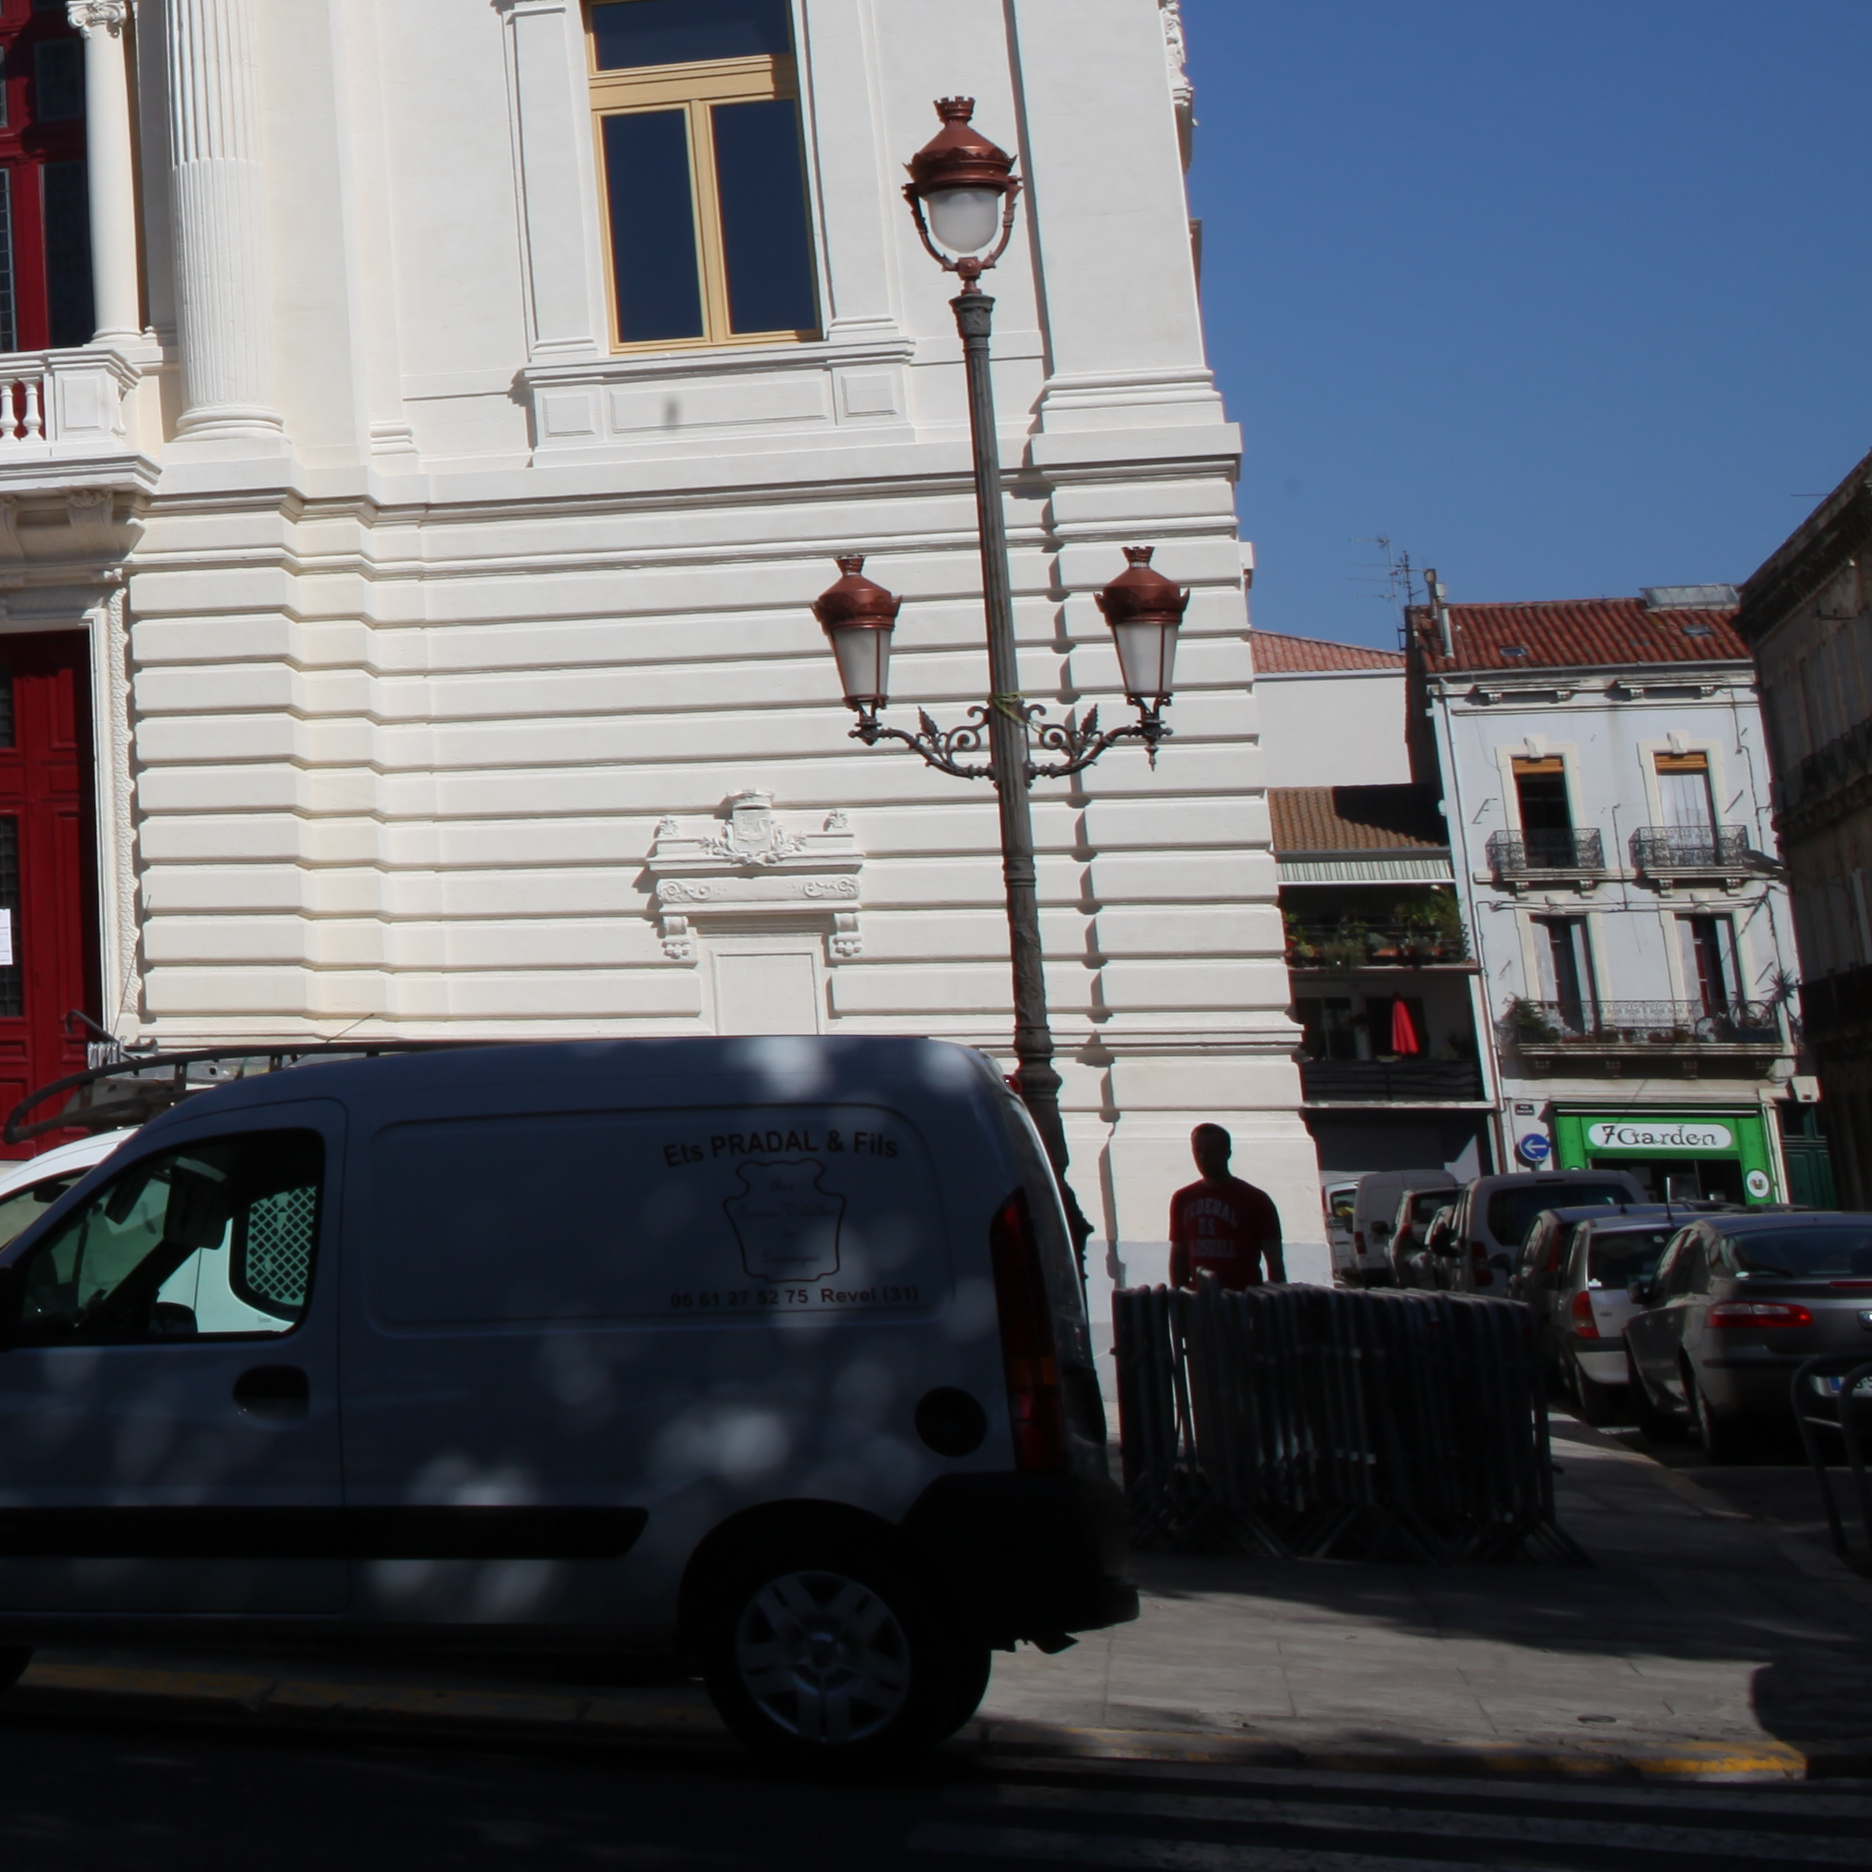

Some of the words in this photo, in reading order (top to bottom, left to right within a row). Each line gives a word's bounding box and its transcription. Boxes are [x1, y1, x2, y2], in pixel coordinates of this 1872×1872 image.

[662, 1143, 704, 1168] Ets
[710, 1130, 819, 1158] PRADAL
[826, 1129, 845, 1153] &
[853, 1131, 899, 1159] Fils
[670, 1292, 693, 1308] 05
[699, 1291, 720, 1307] 61
[728, 1290, 749, 1306] 27
[757, 1289, 779, 1305] 52
[786, 1289, 809, 1304] 75
[820, 1286, 876, 1303] Revel
[883, 1285, 919, 1303] (31)
